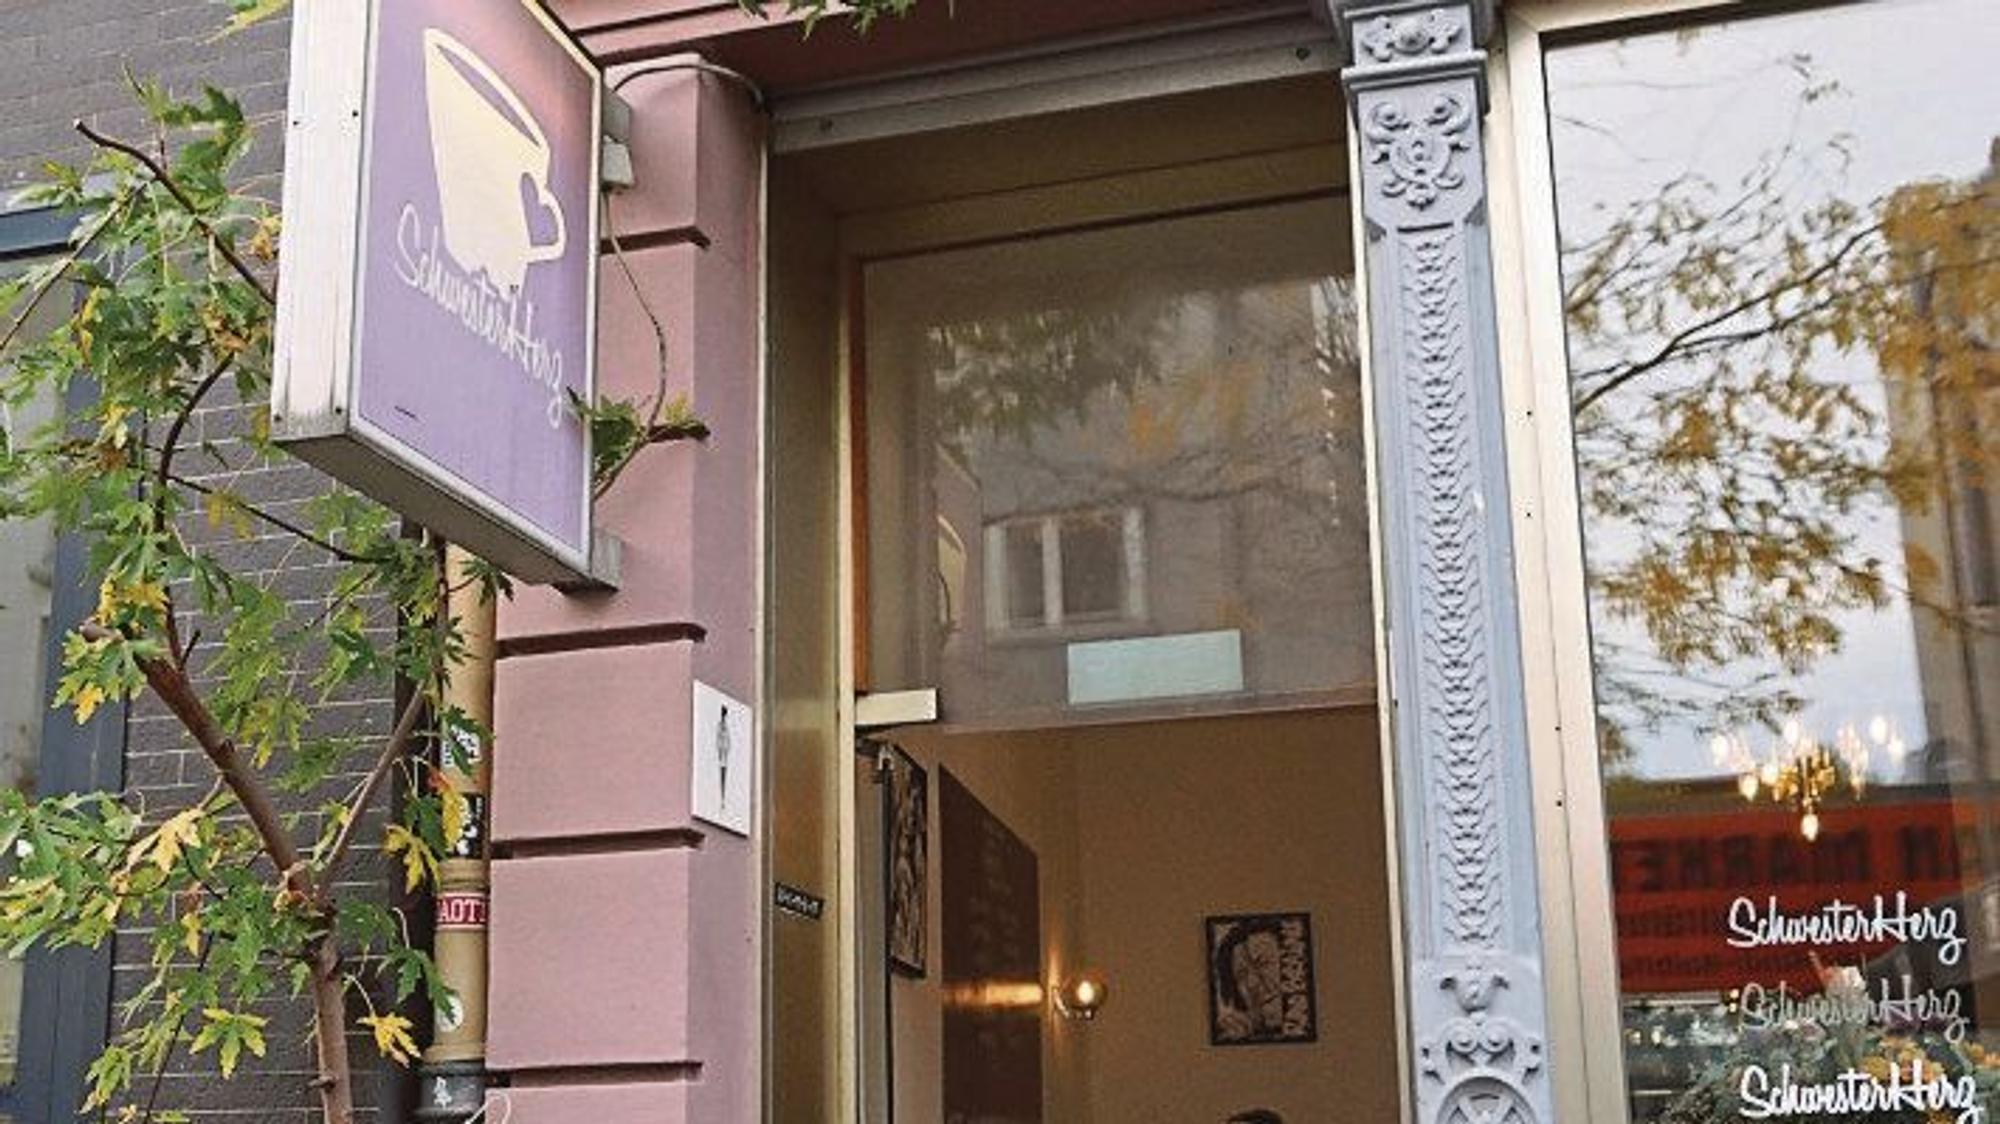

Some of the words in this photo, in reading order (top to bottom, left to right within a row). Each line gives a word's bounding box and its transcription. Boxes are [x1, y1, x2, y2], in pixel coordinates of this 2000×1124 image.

[395, 203, 563, 429] SchwesterHerz
[1727, 890, 1967, 965] SchwesterHerz
[1738, 973, 1970, 1044] SchwesterHerz
[1740, 1058, 1985, 1124] SchwesterHerz
